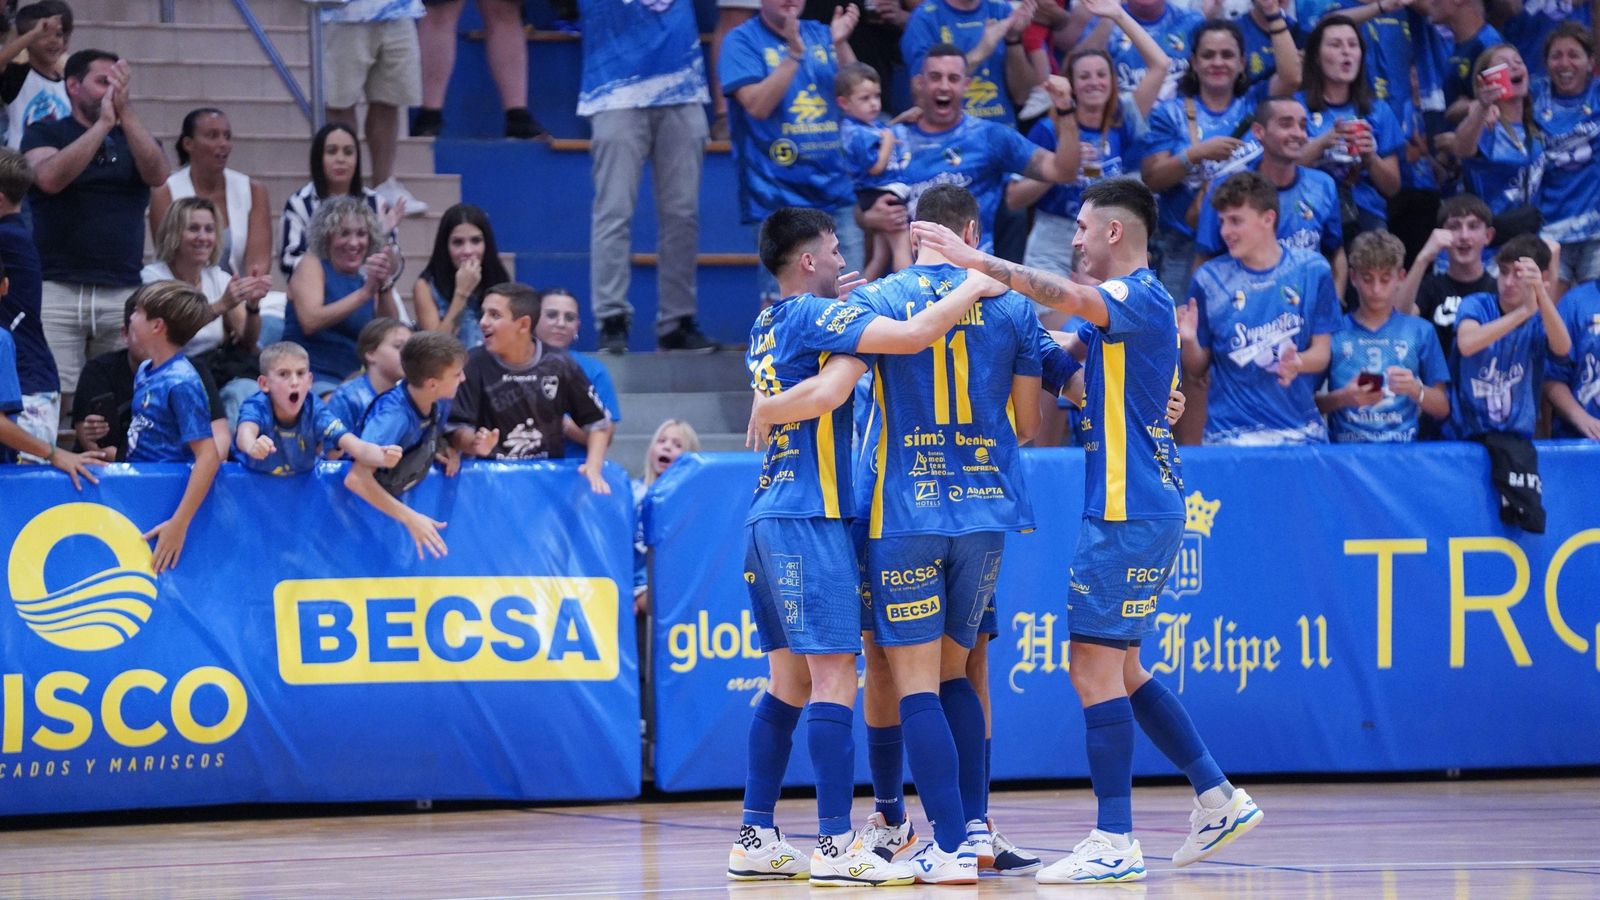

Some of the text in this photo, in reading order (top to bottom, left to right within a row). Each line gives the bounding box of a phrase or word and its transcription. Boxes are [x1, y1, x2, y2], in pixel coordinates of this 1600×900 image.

[929, 330, 973, 425] 11
[966, 486, 1004, 495] ADAPTA
[881, 565, 938, 587] Facsa
[889, 600, 939, 619] BECSA
[297, 594, 601, 664] BECSA
[1151, 612, 1282, 695] Felipe
[85, 758, 96, 775] Y
[109, 752, 226, 774] MARISCOS
